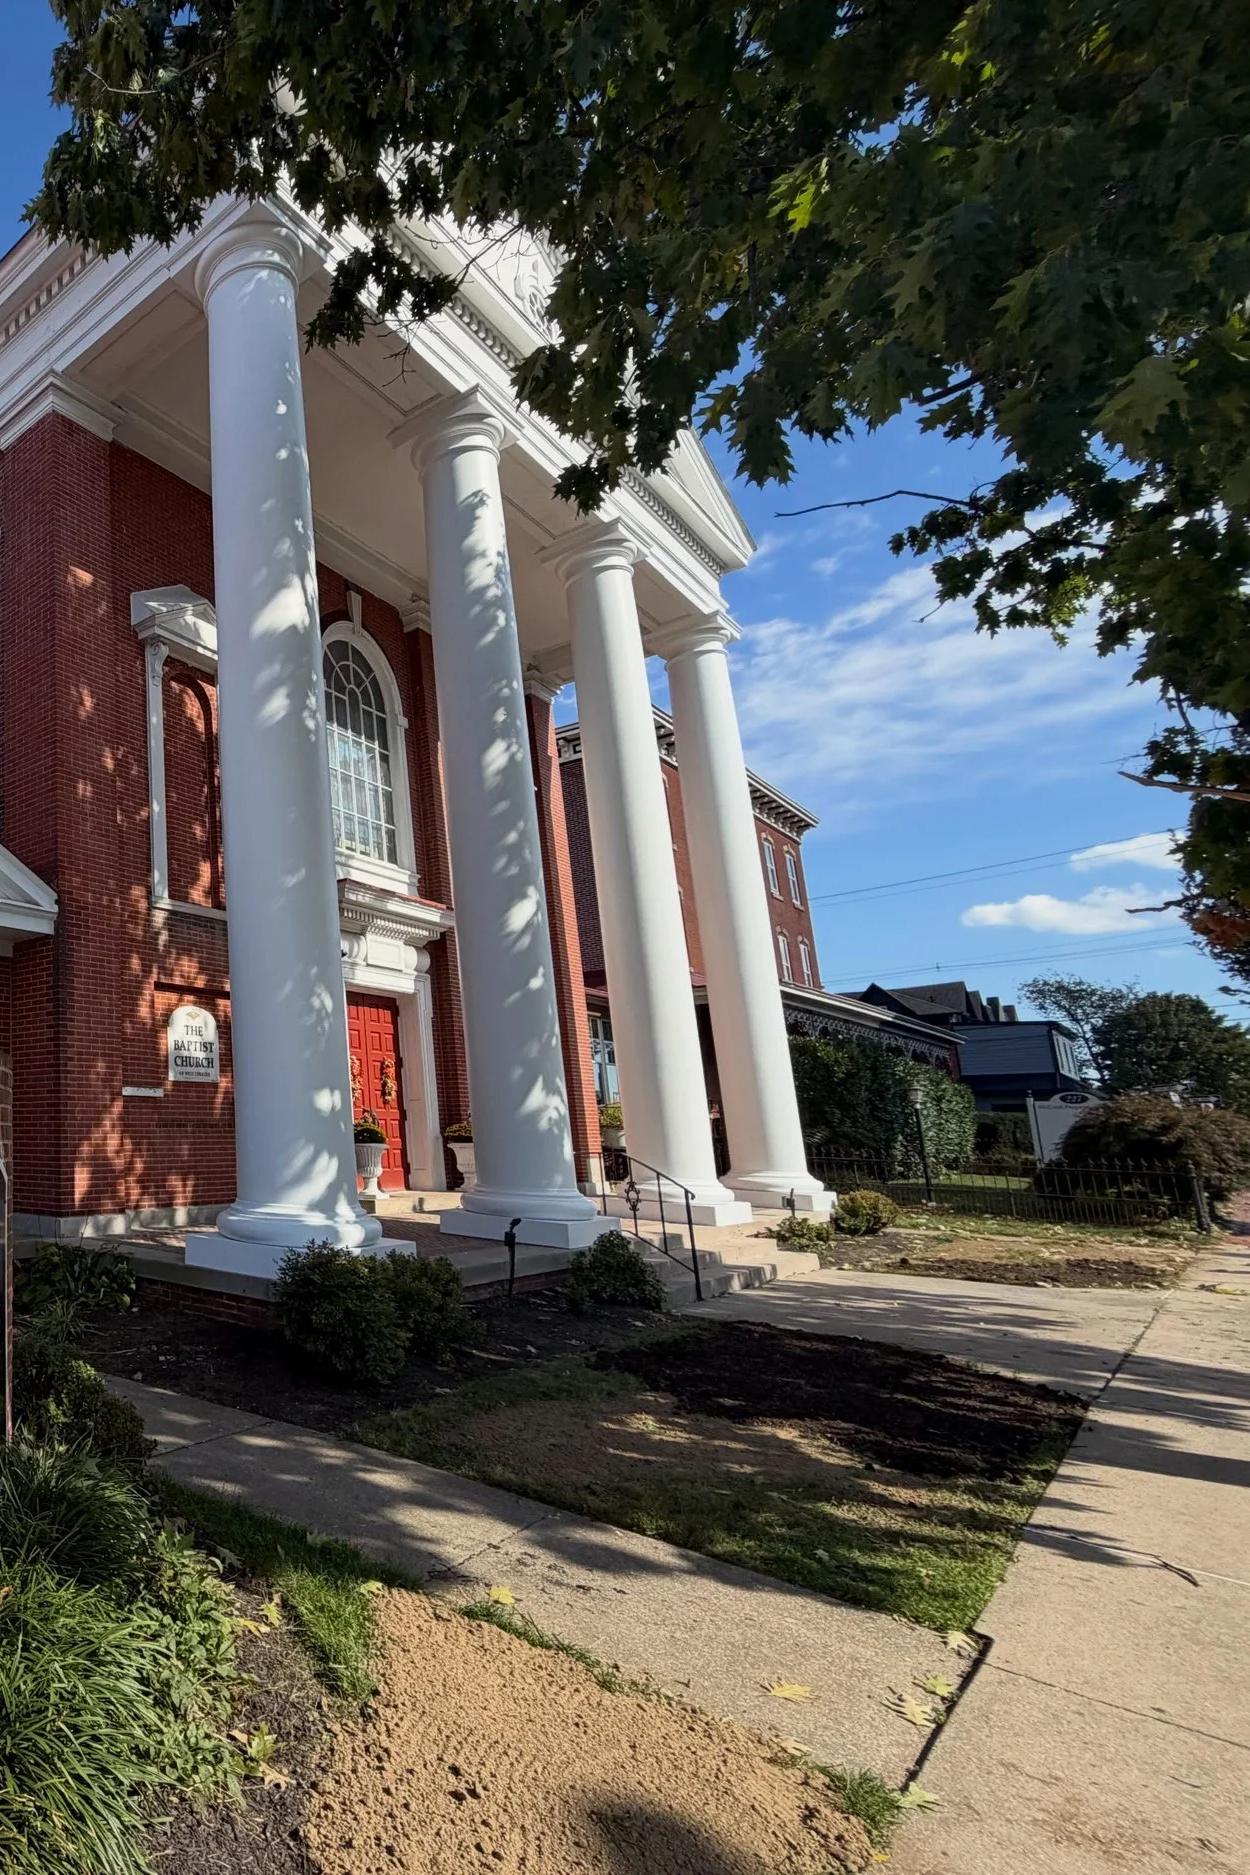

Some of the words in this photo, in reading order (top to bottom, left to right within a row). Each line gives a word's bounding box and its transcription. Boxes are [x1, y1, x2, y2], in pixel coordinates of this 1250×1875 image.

[184, 1025, 203, 1036] THE
[174, 1040, 214, 1053] BAPTIST
[174, 1056, 214, 1068] CHURCH
